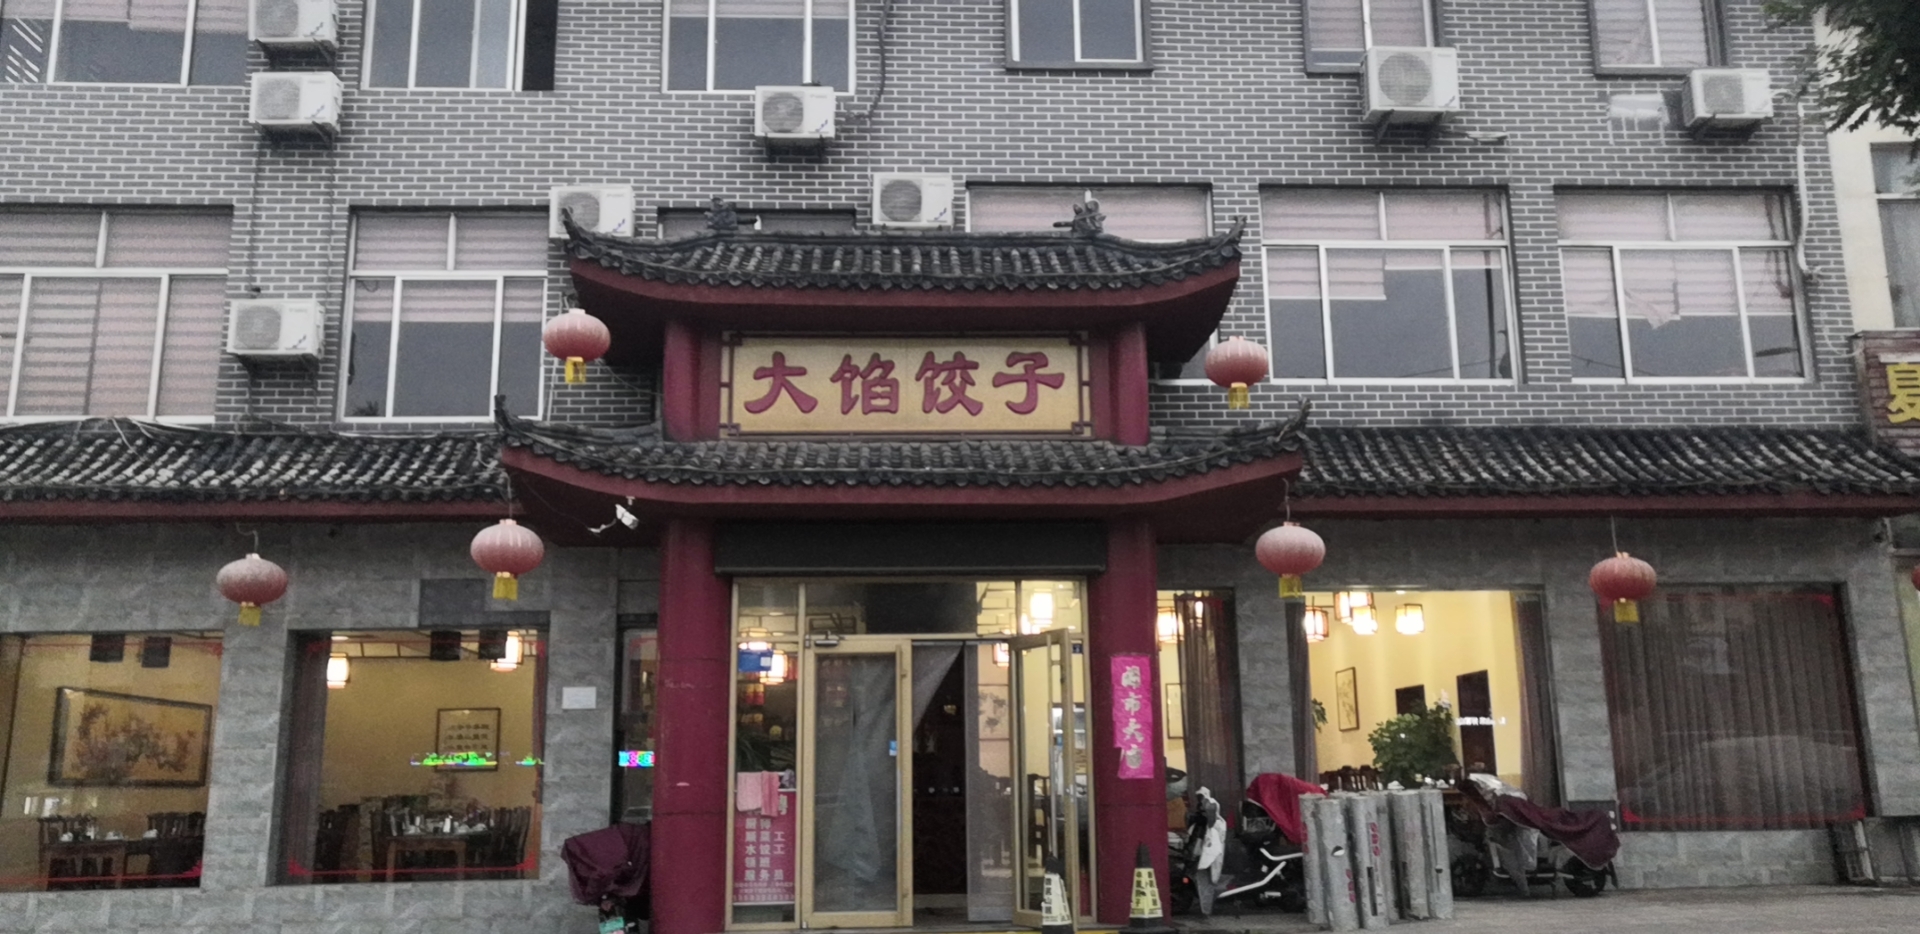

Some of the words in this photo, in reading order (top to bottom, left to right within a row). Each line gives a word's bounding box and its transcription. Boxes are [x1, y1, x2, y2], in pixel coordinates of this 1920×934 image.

[744, 351, 1065, 416] 大馅饺子
[744, 869, 784, 881] 服务员
